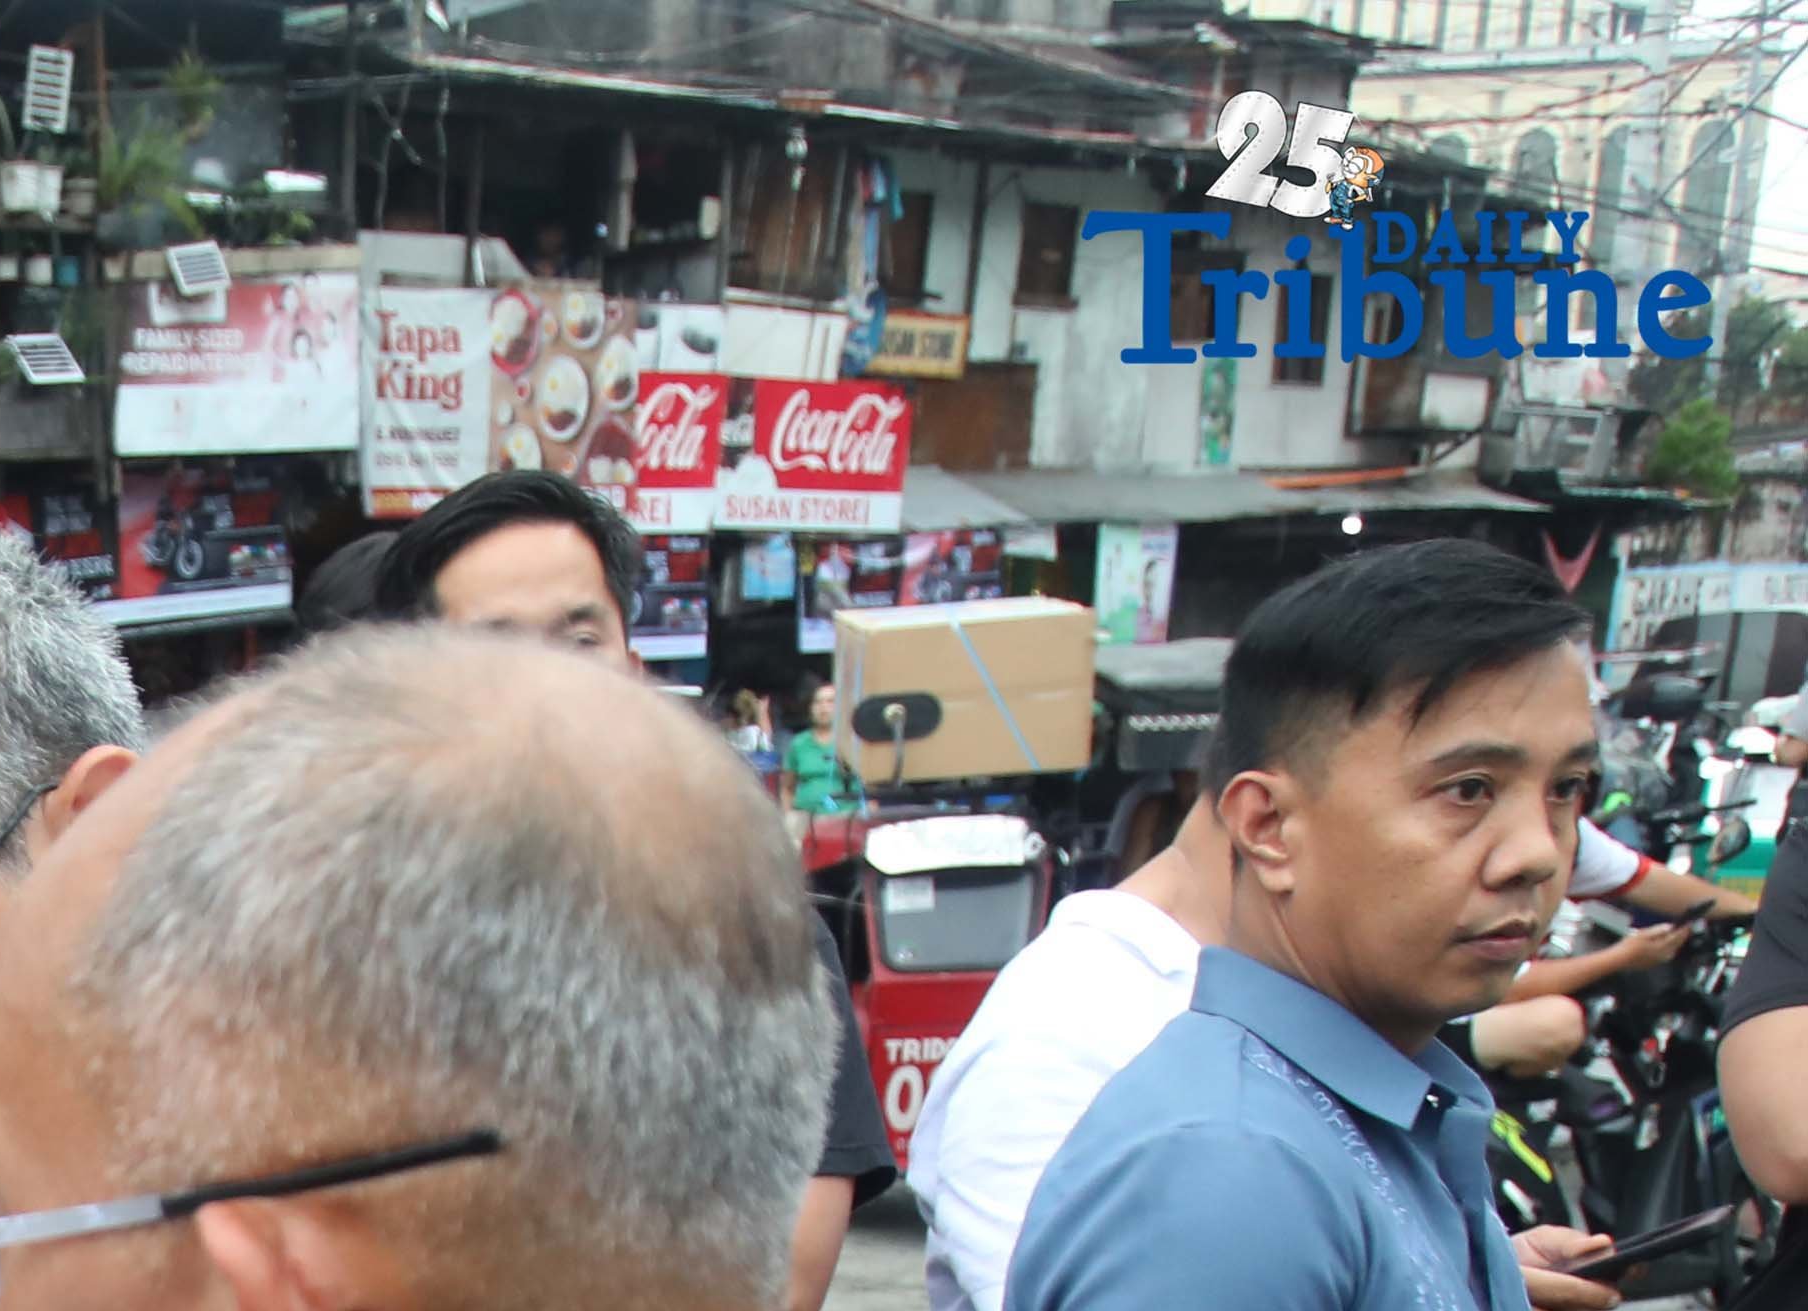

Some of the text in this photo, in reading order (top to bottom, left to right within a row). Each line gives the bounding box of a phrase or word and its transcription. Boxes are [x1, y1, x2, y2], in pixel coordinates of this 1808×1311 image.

[374, 309, 463, 363] Tapa
[375, 364, 464, 411] King
[726, 494, 792, 521] SUSAN
